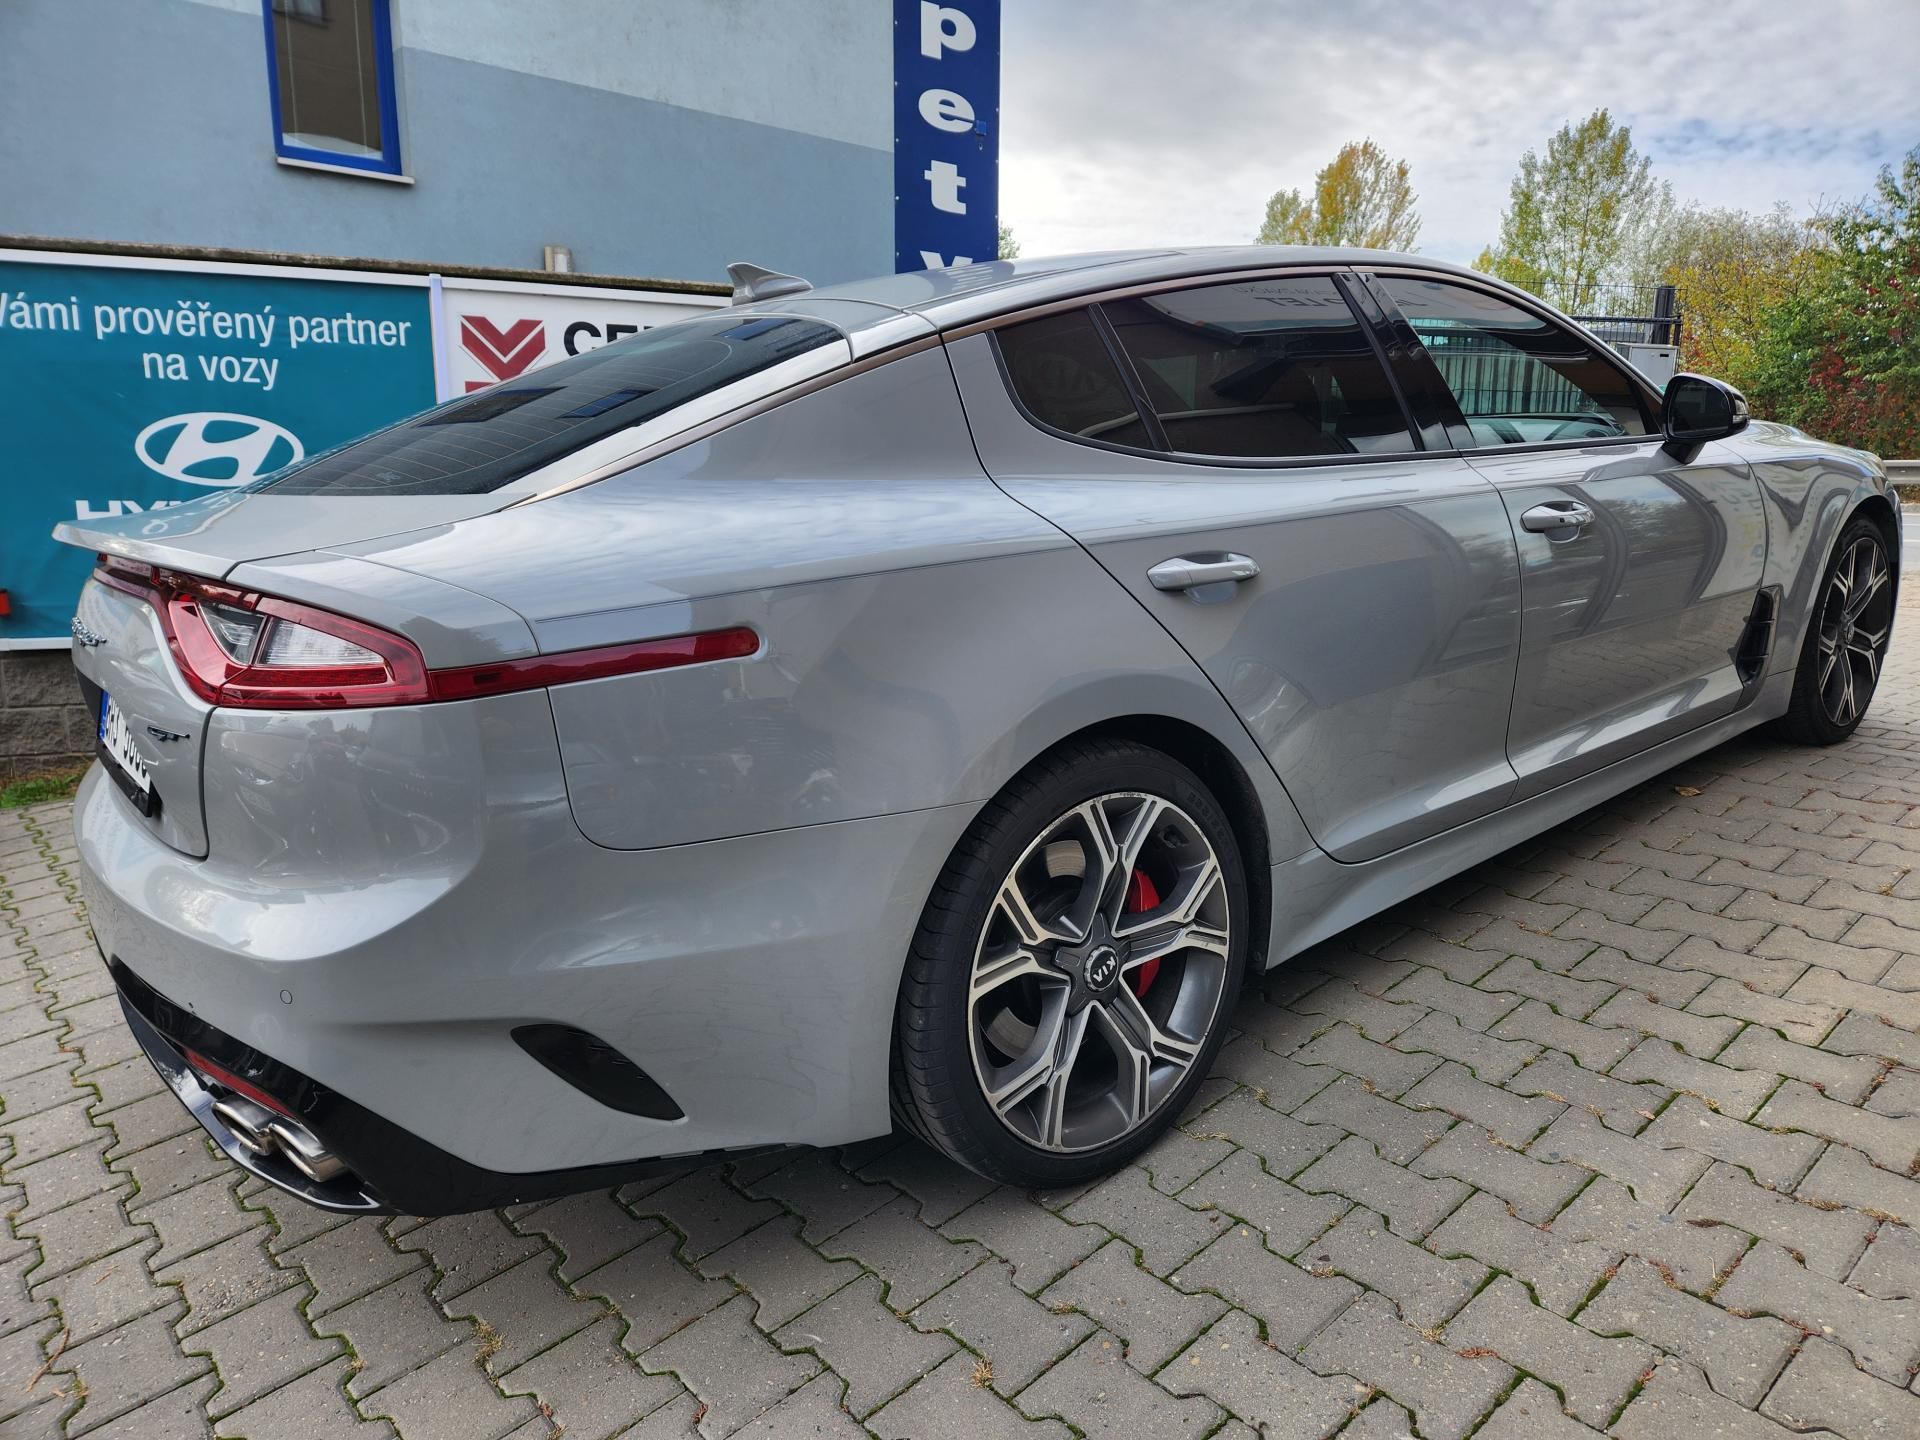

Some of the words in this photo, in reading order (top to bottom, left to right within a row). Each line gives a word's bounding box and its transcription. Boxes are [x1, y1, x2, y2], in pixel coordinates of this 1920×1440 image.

[94, 300, 275, 348] prověřený
[288, 312, 412, 349] partner
[142, 352, 189, 381] na
[198, 355, 279, 391] vozy
[1092, 955, 1117, 983] KIA
